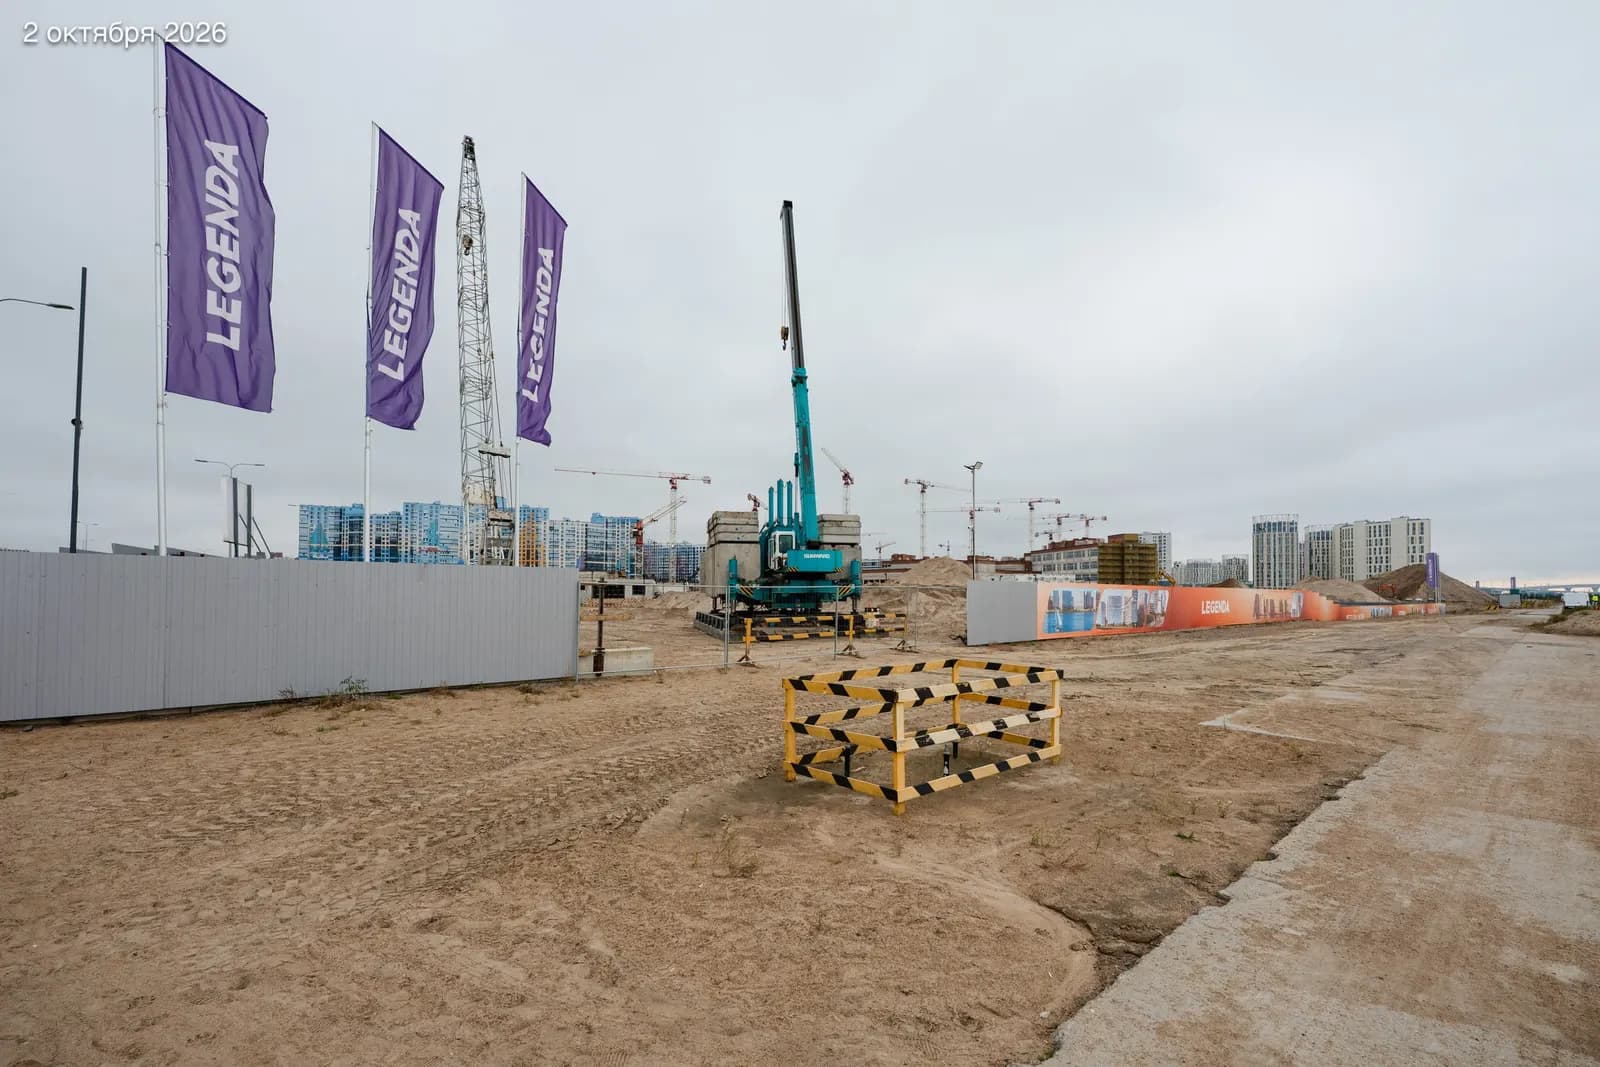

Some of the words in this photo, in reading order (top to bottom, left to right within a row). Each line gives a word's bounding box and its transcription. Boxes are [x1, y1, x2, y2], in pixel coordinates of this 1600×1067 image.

[204, 139, 242, 351] LEGENDA
[378, 208, 420, 382] LEGENDA
[522, 247, 554, 403] LEGENDA
[1201, 599, 1230, 615] LEGENDA
